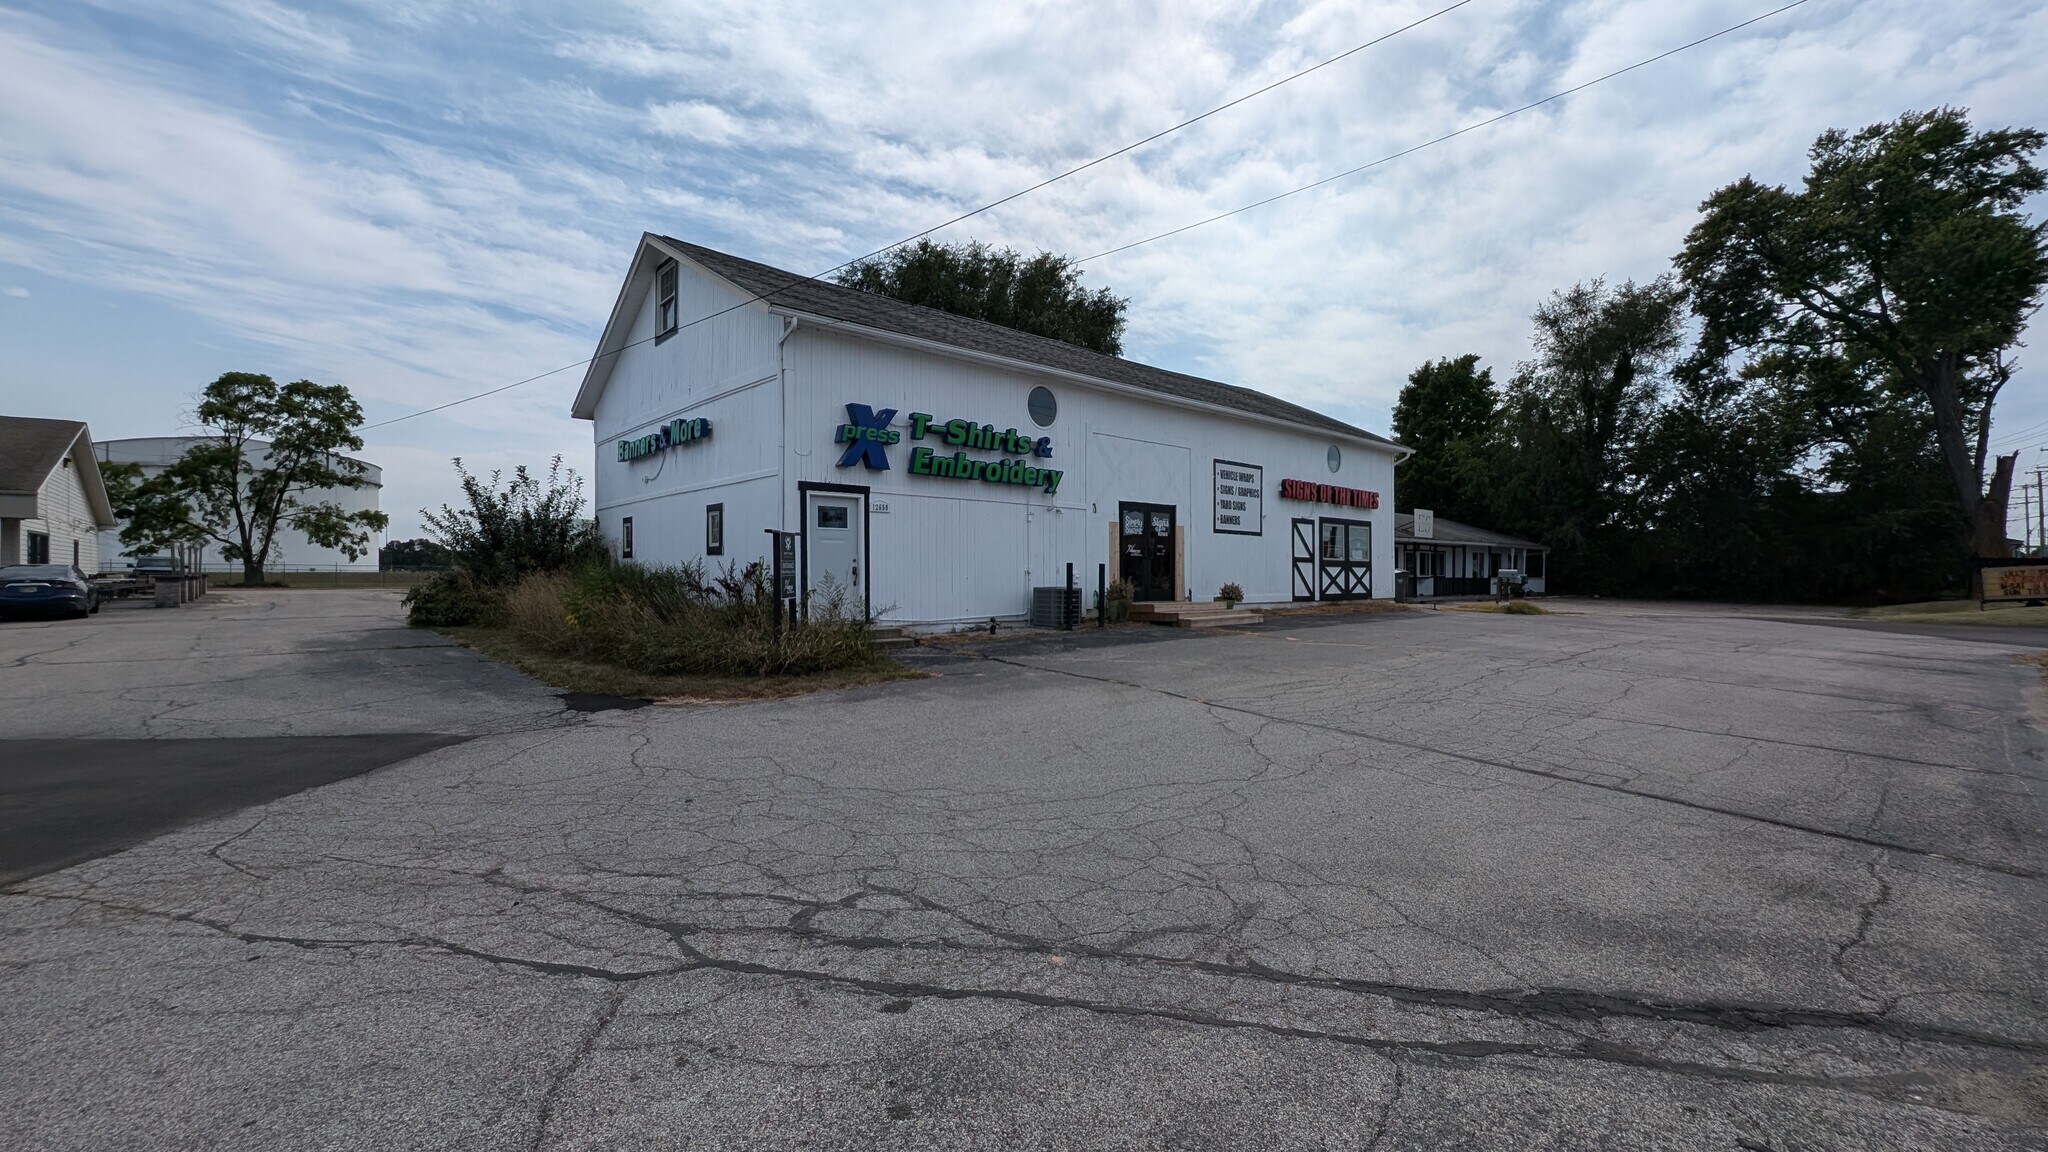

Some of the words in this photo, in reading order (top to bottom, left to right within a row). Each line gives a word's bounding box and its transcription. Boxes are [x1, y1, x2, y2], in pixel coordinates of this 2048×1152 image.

[618, 433, 660, 462] Banners
[660, 425, 671, 449] &
[670, 418, 708, 446] More
[909, 412, 1032, 455] T-Shirts
[1035, 436, 1053, 458] &
[908, 447, 1064, 493] Embroidery
[1220, 469, 1238, 481] VEHICLE
[1239, 472, 1255, 484] WRAPS
[1220, 484, 1234, 495] SIGNS
[1238, 486, 1260, 499] GRAPHICS
[1282, 479, 1317, 502] SIGNS
[1319, 484, 1333, 504] OF
[1334, 486, 1352, 506] THE
[1353, 489, 1380, 509] TIMES
[1220, 499, 1232, 510] YARD
[1233, 501, 1246, 511] SIGNS
[1220, 514, 1241, 525] BANNERS
